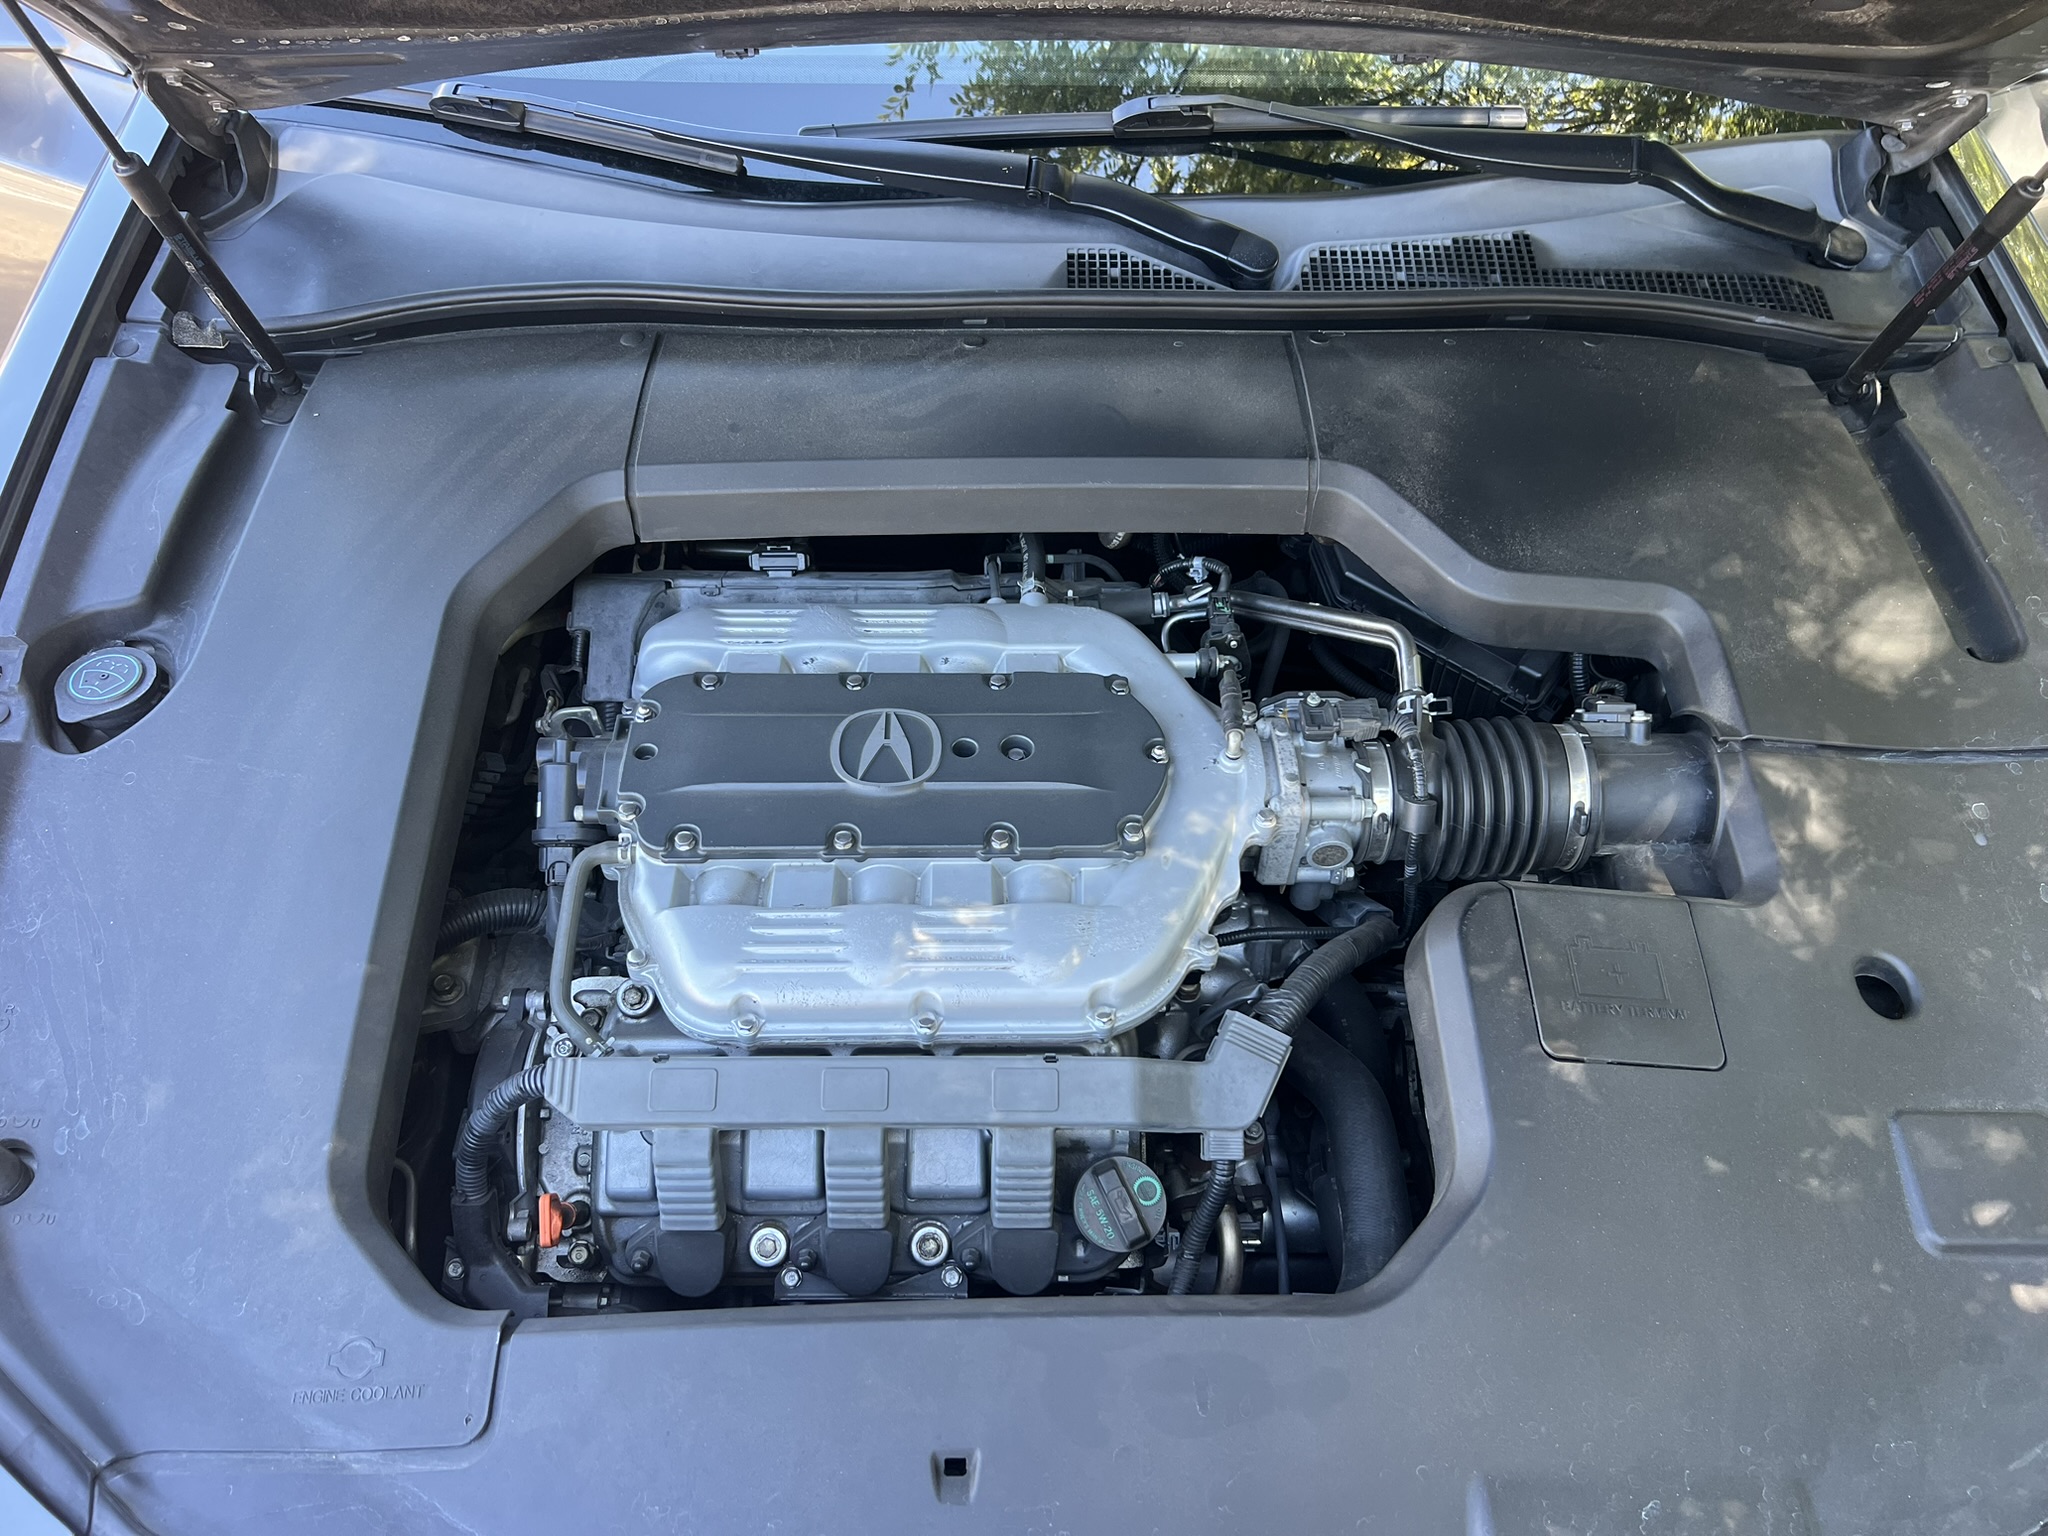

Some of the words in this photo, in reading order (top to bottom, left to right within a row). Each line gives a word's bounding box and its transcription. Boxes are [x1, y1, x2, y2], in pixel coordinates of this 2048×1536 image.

[1561, 1000, 1623, 1016] BATTERY
[1086, 1189, 1100, 1208] SAE
[1095, 1208, 1116, 1240] 5W-20
[291, 1388, 346, 1404] ENGINE
[351, 1384, 425, 1402] COOLANT
